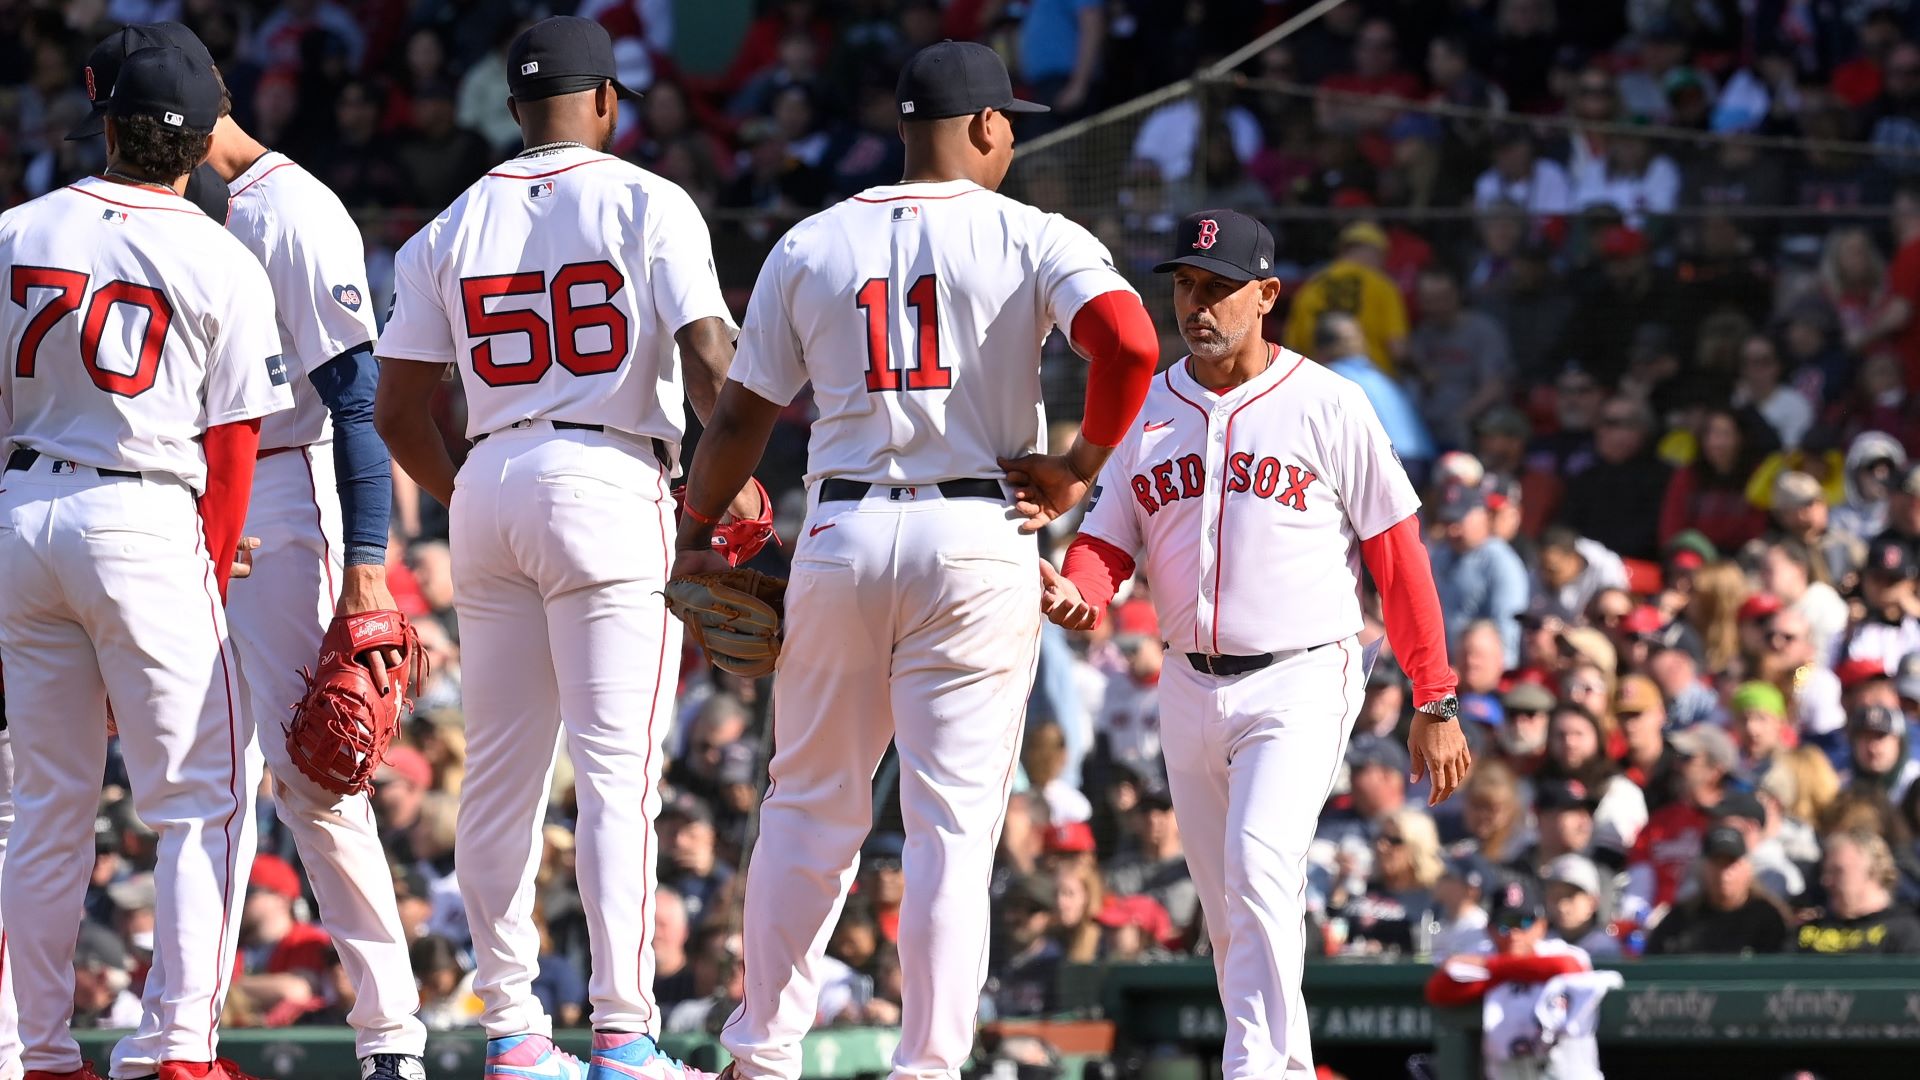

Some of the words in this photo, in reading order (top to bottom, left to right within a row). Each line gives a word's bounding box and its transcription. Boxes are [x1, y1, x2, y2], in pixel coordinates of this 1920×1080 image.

[1192, 219, 1220, 250] B
[11, 264, 174, 399] 70
[460, 260, 629, 388] 56
[855, 273, 952, 393] 11
[1131, 453, 1206, 517] RED
[1227, 451, 1317, 512] SOX
[1178, 1006, 1225, 1038] BA
[1324, 1005, 1433, 1039] AMERI
[1627, 985, 1717, 1025] xfinity
[1763, 982, 1855, 1024] xfinity
